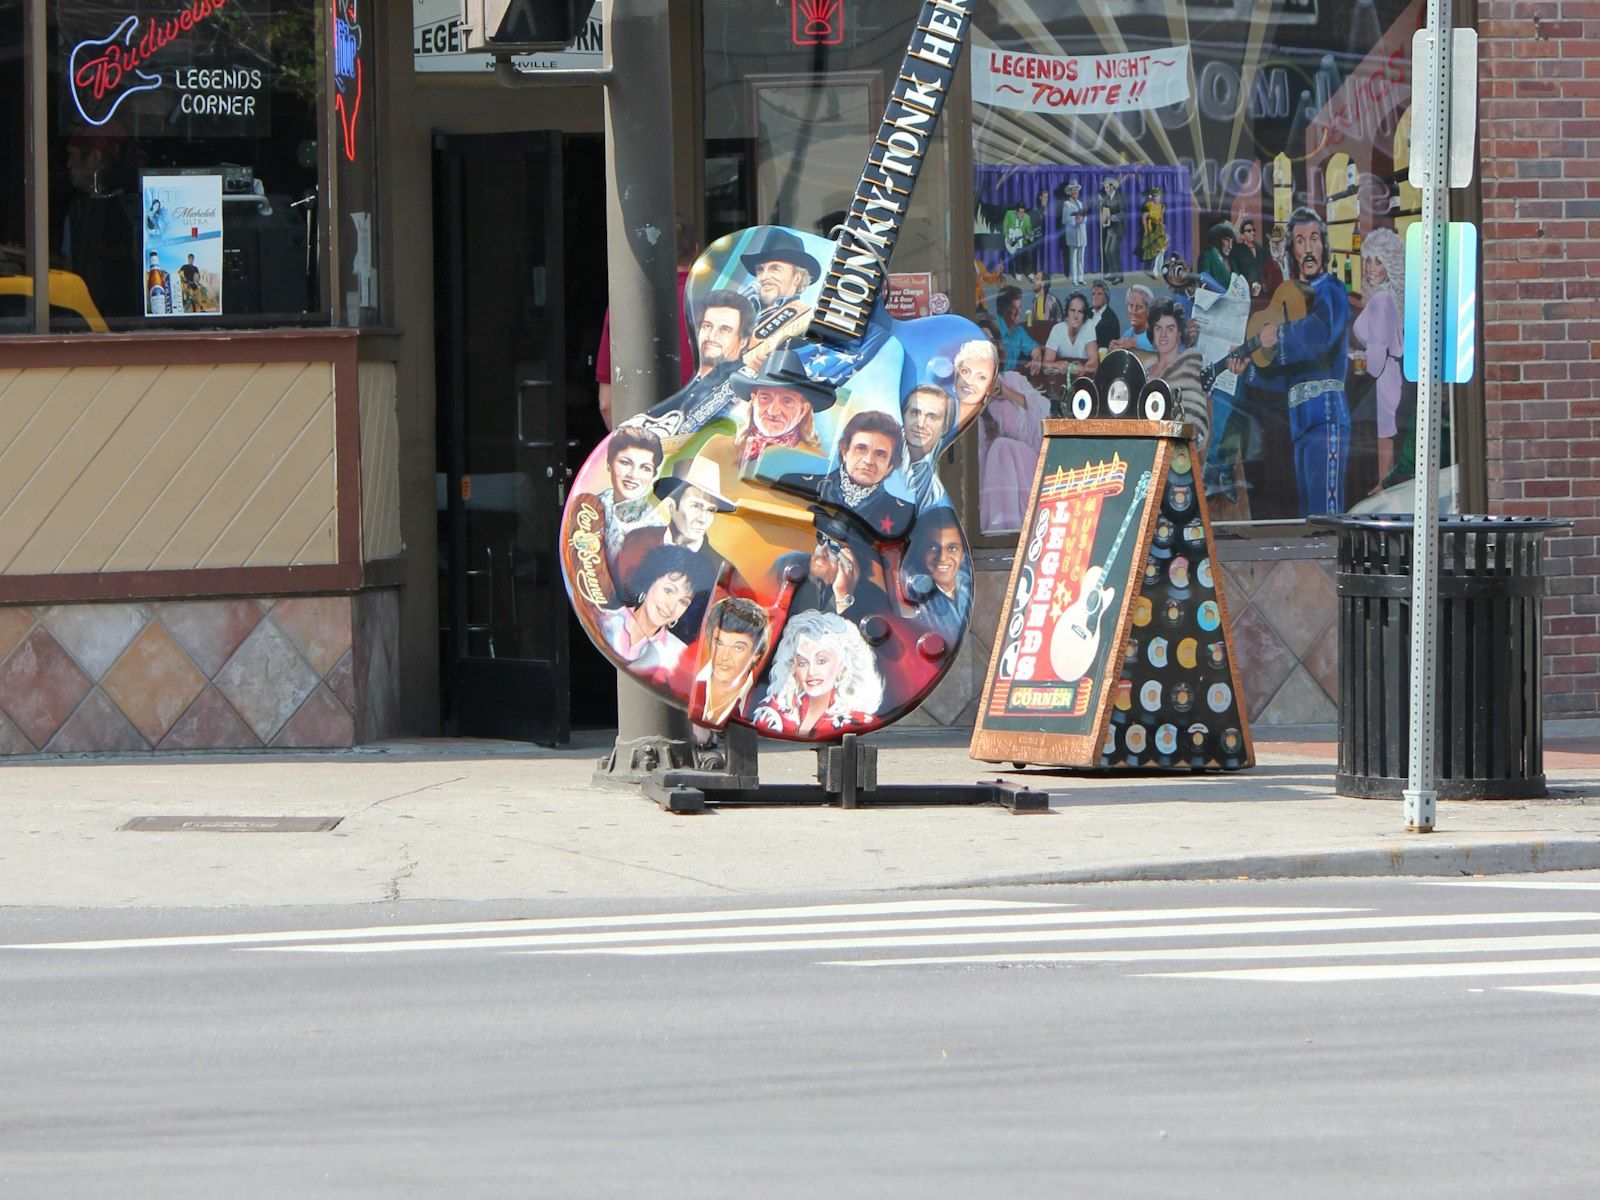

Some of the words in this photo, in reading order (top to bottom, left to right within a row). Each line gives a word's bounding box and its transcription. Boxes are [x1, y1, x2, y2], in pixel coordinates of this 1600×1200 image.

[486, 61, 558, 69] NHVILLE
[989, 52, 1079, 81] LEGENDS
[1095, 54, 1151, 80] NIGHT
[176, 69, 262, 90] LEGENDS
[181, 94, 256, 116] CORNER
[1030, 82, 1123, 107] TONITE
[823, 74, 943, 332] HONKY-TONK
[1061, 498, 1082, 573] LIVE
[1070, 497, 1097, 582] MUSIC
[1014, 501, 1071, 682] LEGENDS
[1010, 684, 1073, 708] CORNER
